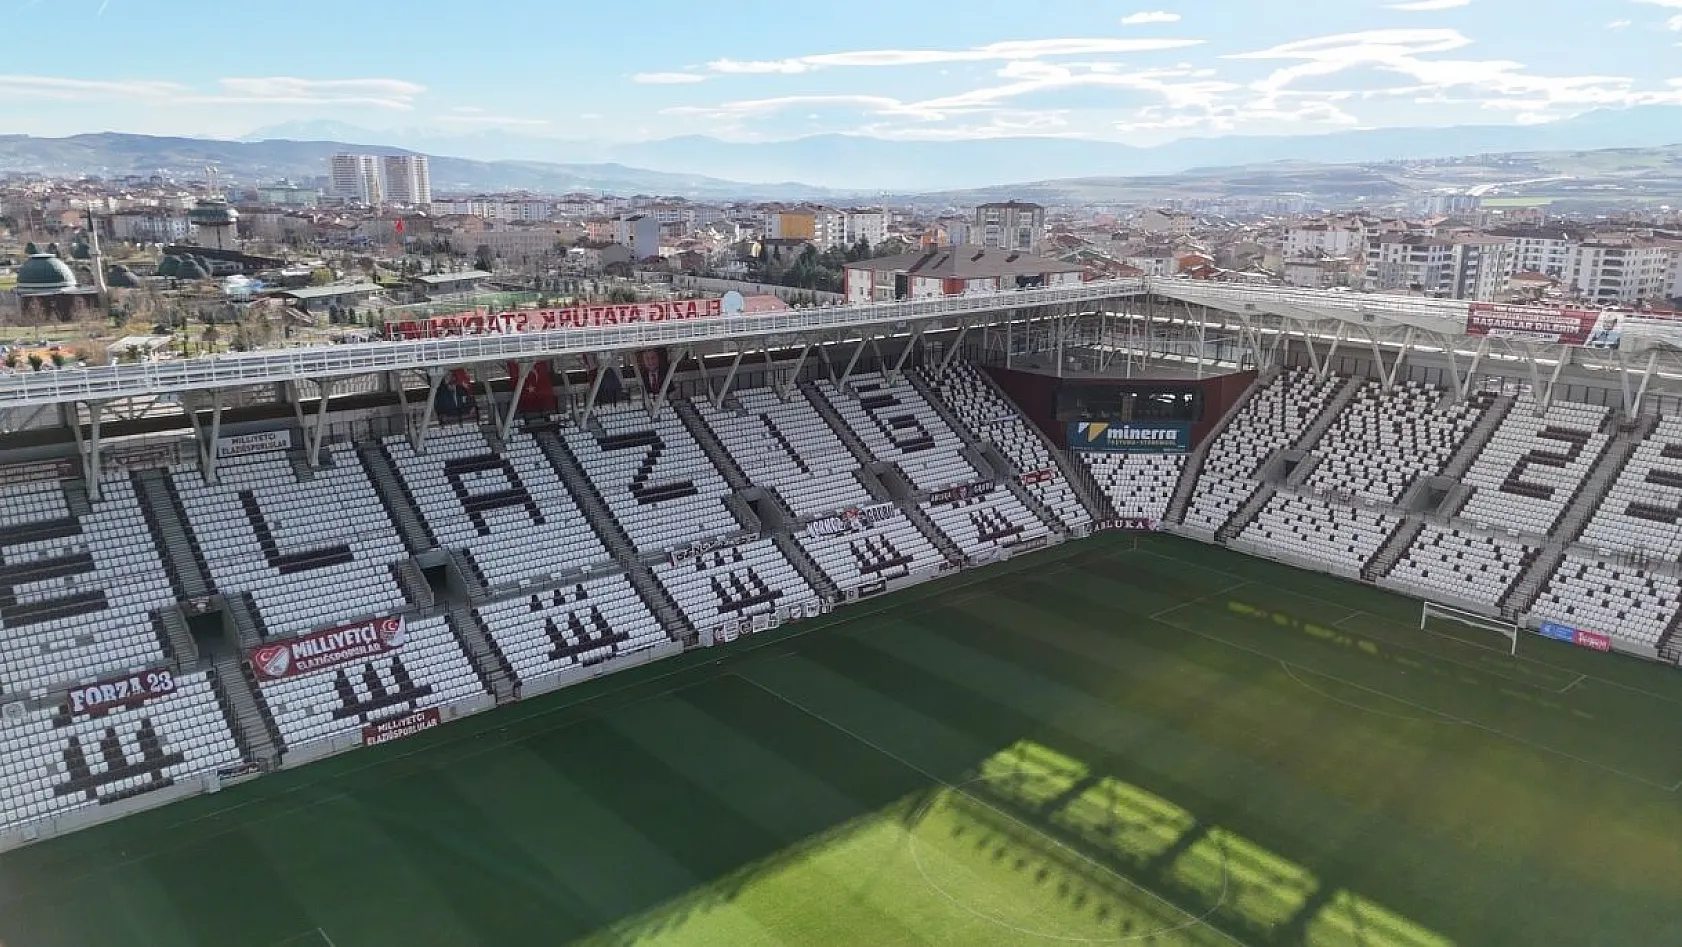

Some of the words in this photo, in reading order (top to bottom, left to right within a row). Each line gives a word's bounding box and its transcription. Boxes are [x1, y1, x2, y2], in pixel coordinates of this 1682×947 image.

[1107, 424, 1178, 440] minerra
[70, 677, 145, 712] FORZA
[147, 670, 174, 692] 23
